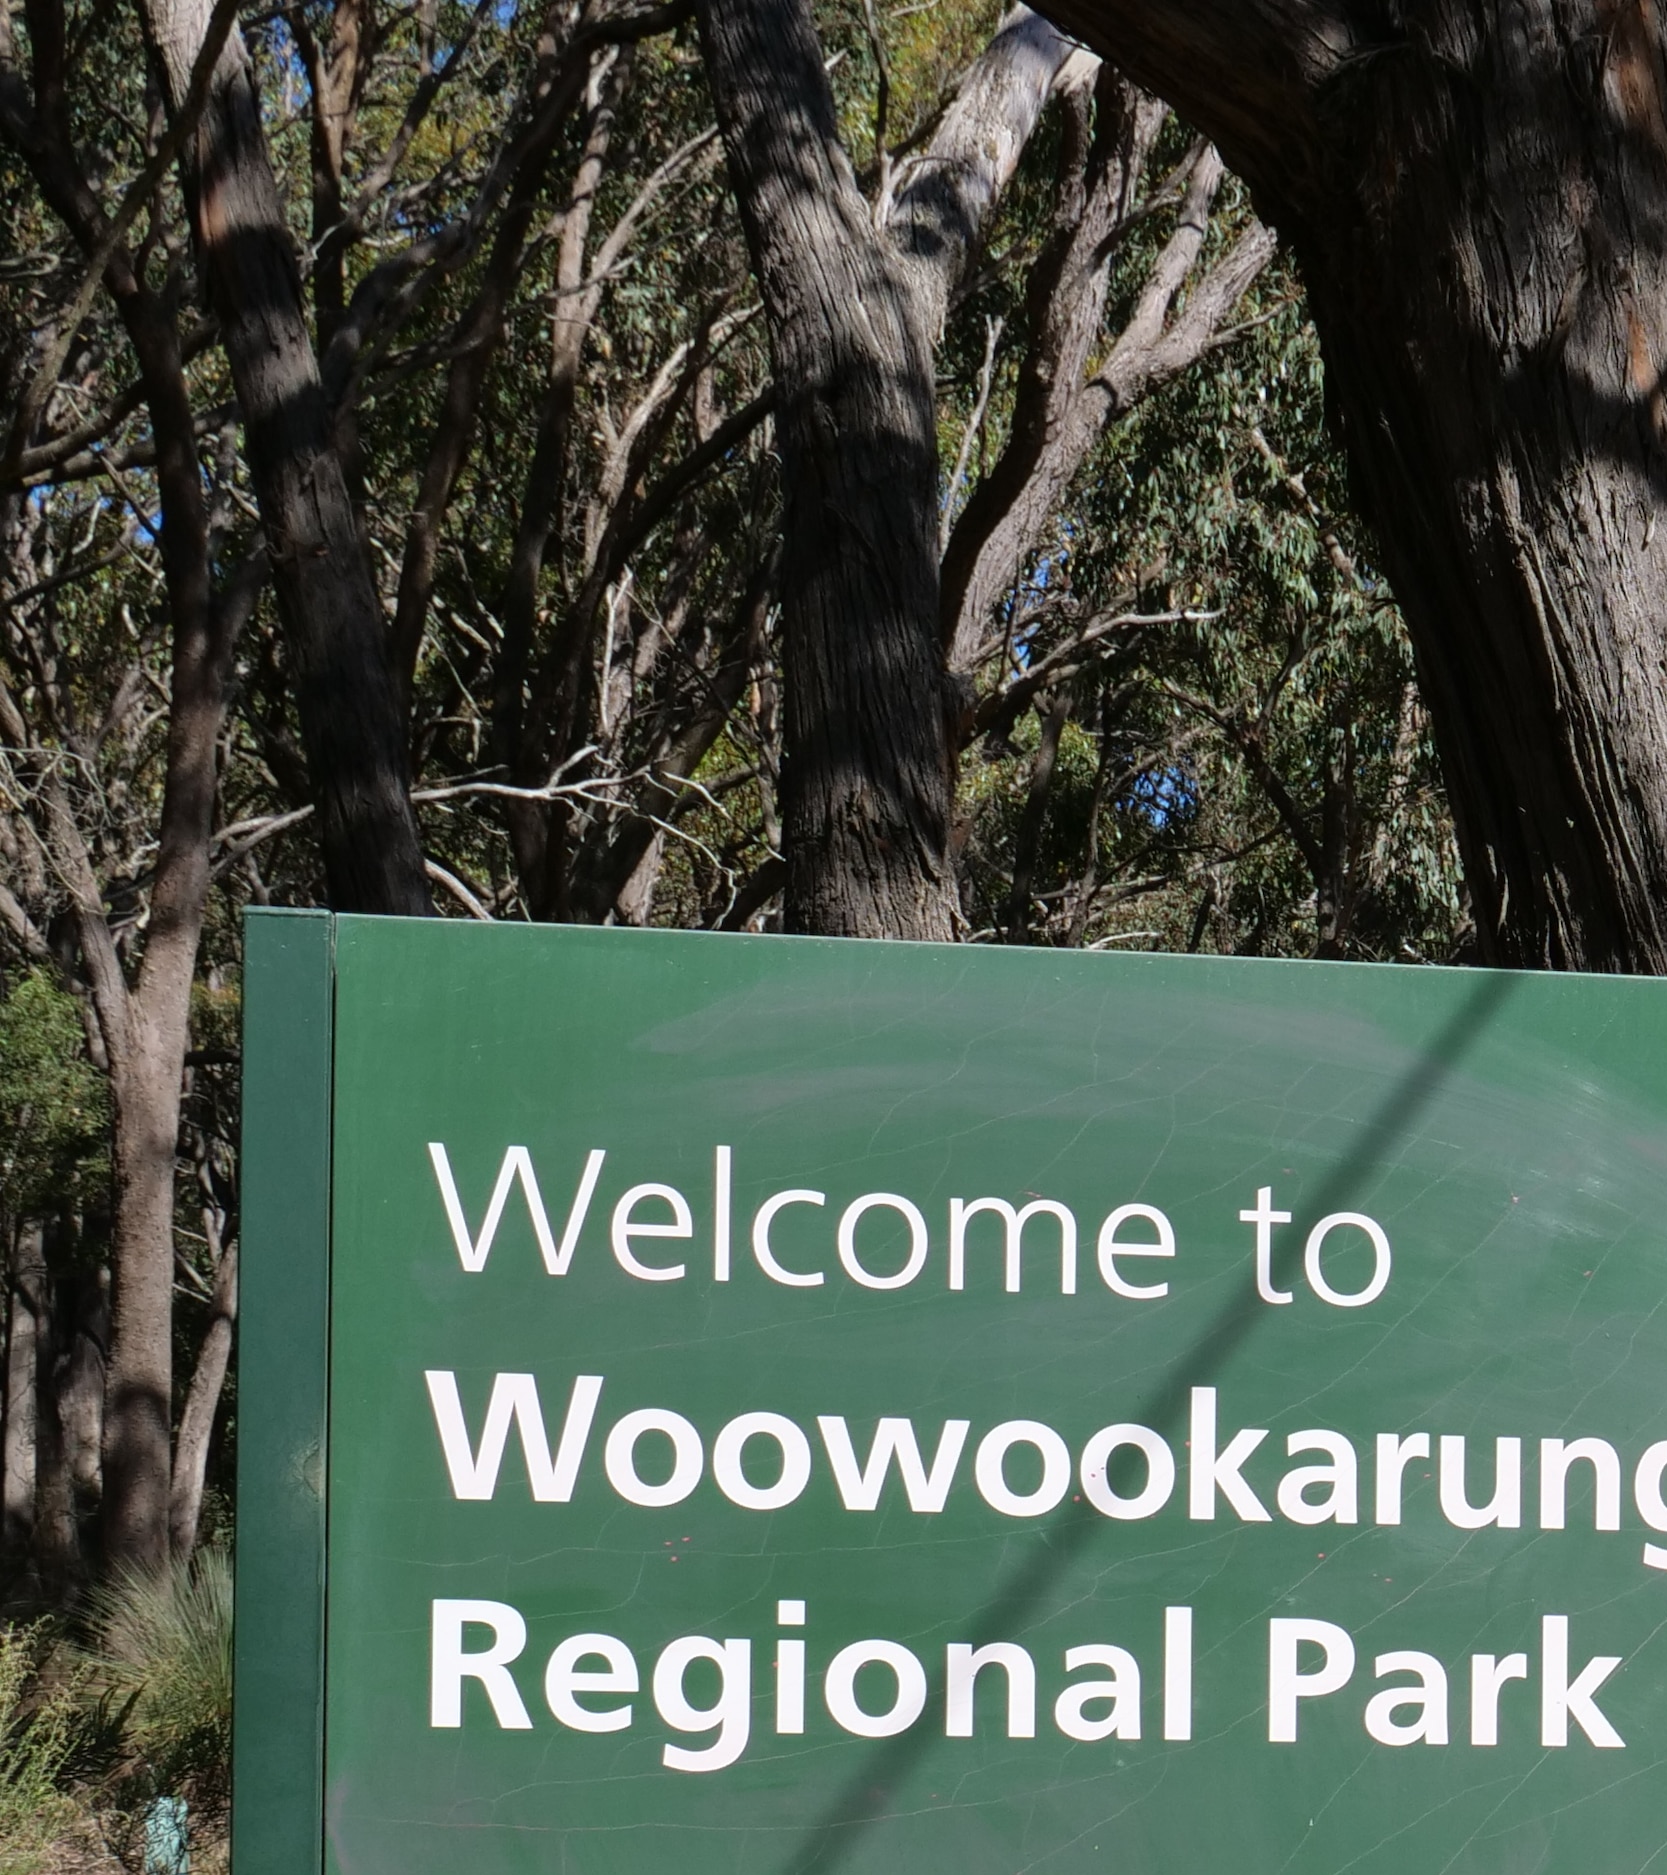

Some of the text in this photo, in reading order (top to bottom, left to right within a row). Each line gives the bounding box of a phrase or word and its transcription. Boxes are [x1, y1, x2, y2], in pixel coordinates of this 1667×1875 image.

[427, 1141, 1392, 1308] Welcome to
[430, 1598, 1627, 1773] Regional Park
